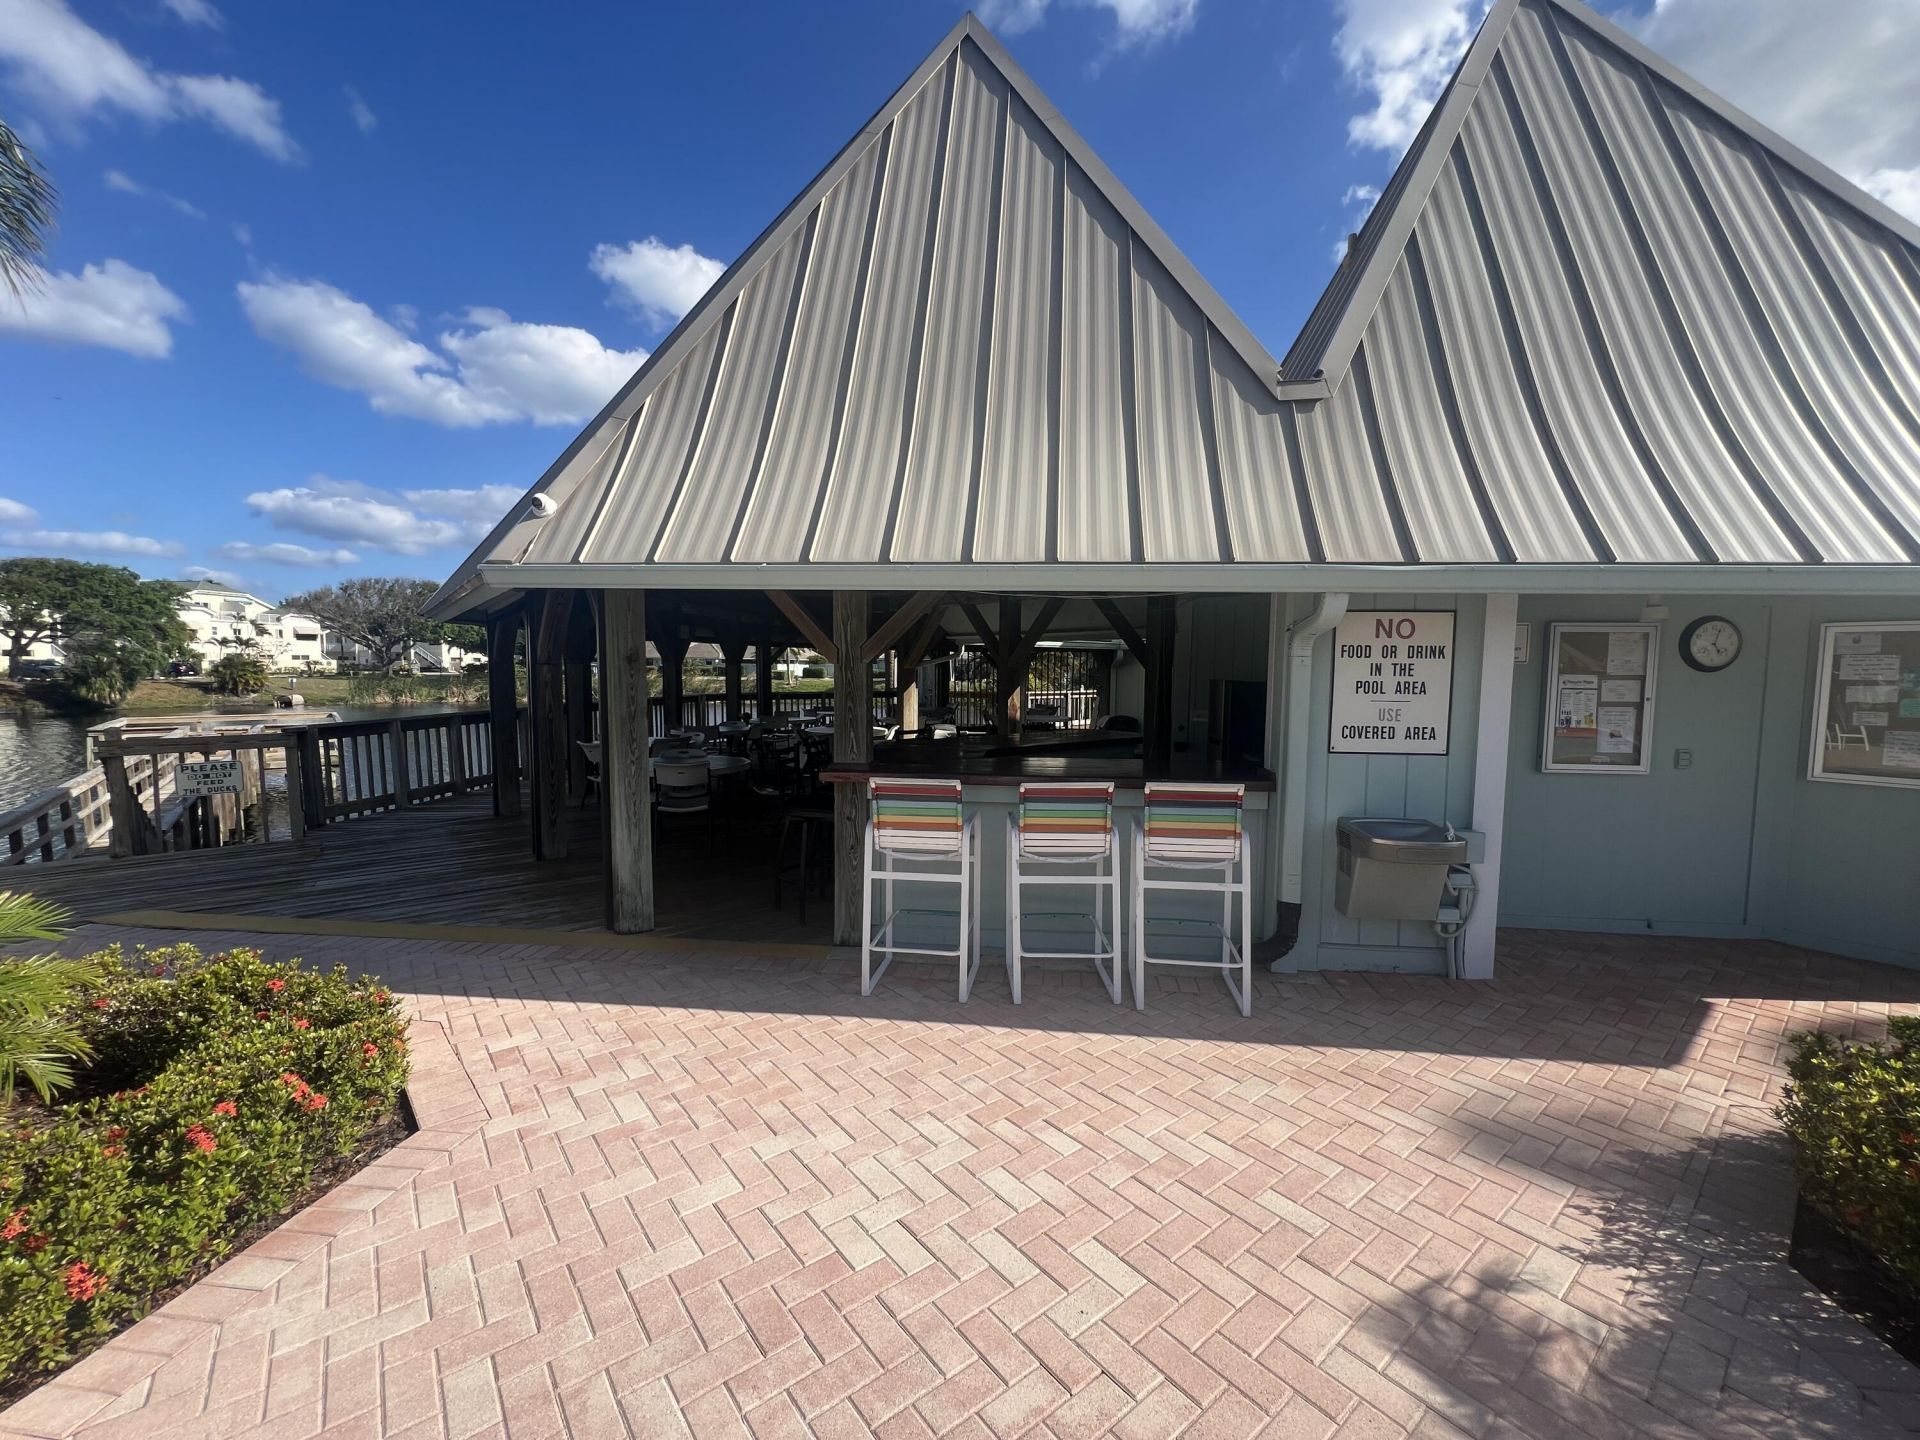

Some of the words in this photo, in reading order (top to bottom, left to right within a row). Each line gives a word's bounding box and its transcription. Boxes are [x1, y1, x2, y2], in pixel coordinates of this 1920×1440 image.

[1375, 618, 1416, 640] NO
[1340, 644, 1372, 659] FOOD
[1381, 645, 1398, 659] OR
[1407, 645, 1446, 660] DRINK
[1369, 662, 1382, 677] IN
[1391, 662, 1415, 677] THE
[1355, 680, 1386, 695] POOL
[1394, 681, 1427, 695] AREA
[1378, 708, 1402, 722] USE
[1341, 725, 1395, 740] COVERED
[1404, 726, 1436, 741] AREA
[180, 763, 238, 773] PLEASE
[207, 785, 238, 793] DUCKS
